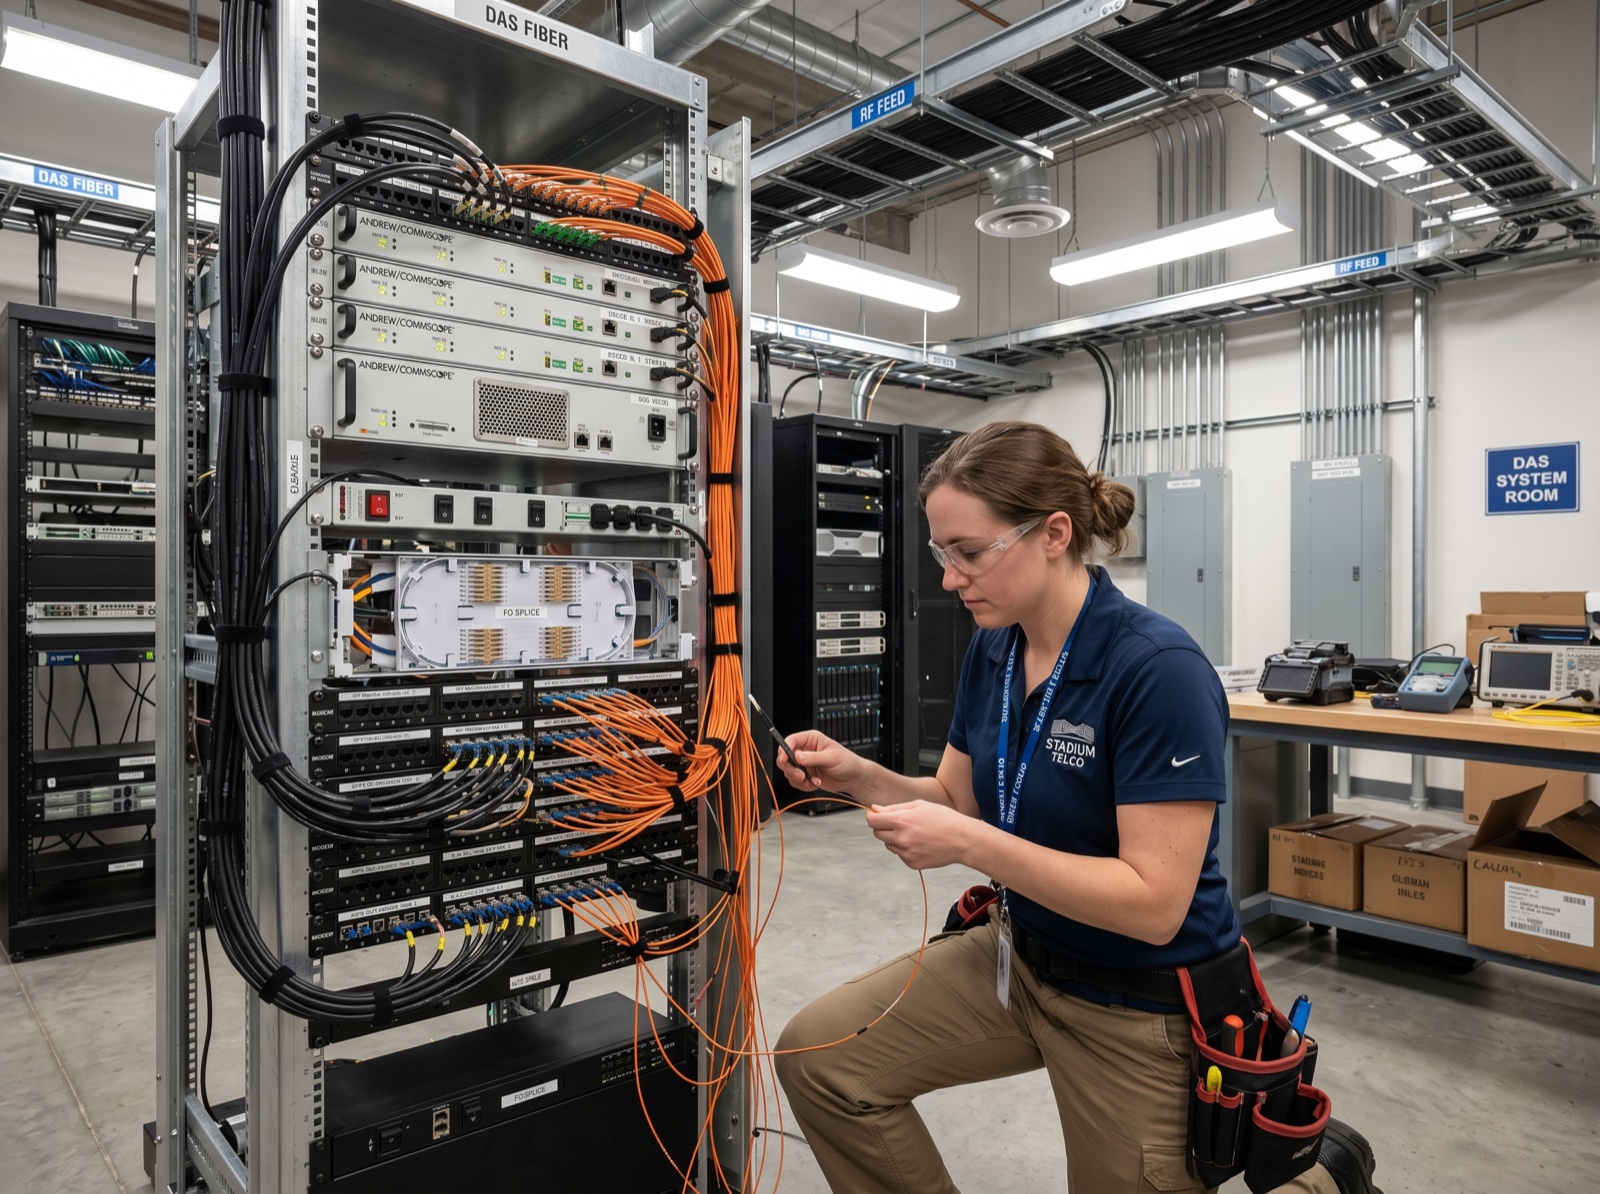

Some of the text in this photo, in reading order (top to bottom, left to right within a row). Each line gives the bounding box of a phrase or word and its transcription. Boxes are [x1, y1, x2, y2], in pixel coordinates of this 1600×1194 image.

[486, 5, 569, 51] DAS FIBER
[860, 89, 906, 123] RF FEED
[38, 169, 114, 197] DAS FIBER
[1340, 256, 1380, 273] RF FEED
[1513, 455, 1550, 470] DAS
[1496, 470, 1567, 488] SYSTEM
[1505, 488, 1558, 504] ROOM
[503, 608, 540, 617] FO SPLICE
[1045, 737, 1096, 759] STADIUM
[1051, 751, 1085, 768] TELCO
